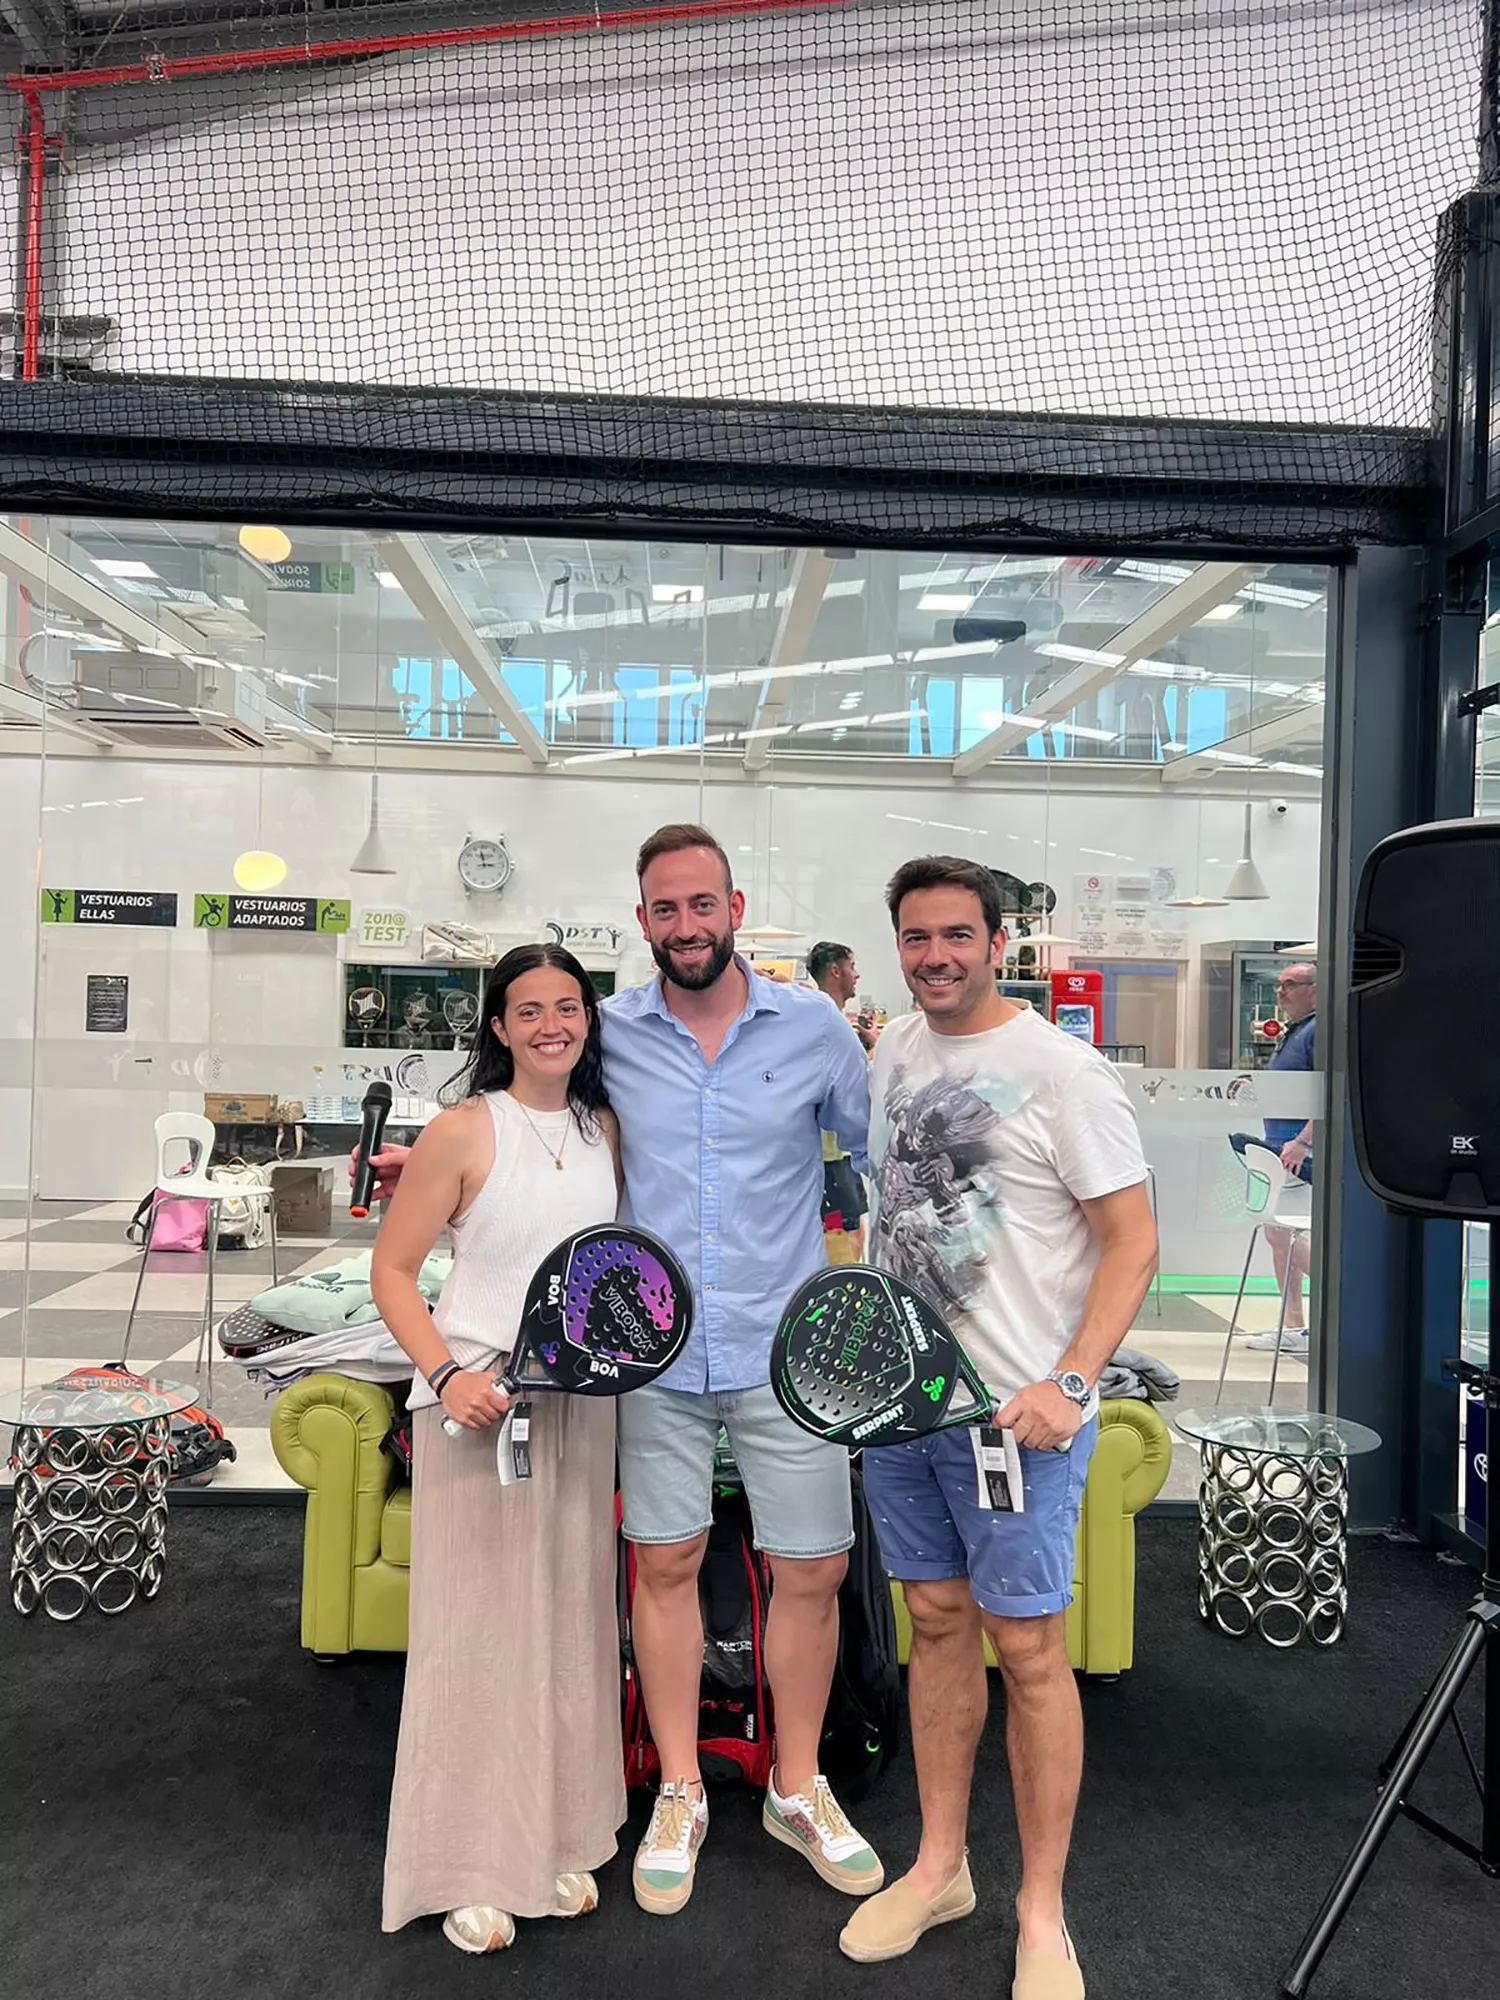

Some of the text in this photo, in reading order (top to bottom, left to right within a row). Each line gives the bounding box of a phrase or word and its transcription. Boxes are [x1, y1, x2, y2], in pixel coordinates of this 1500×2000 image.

[80, 894, 153, 907] VESTUARIOS
[234, 899, 307, 912] VESTUARIOS
[79, 909, 115, 920] ELLAS
[233, 914, 305, 926] ADAPTADOS
[363, 926, 406, 941] TEST
[565, 927, 603, 939] DST
[1452, 1136, 1474, 1150] EK
[547, 1274, 562, 1306] BOA
[900, 1294, 930, 1352] SERPENT
[589, 1360, 620, 1379] BOA
[851, 1402, 906, 1441] SERPENT
